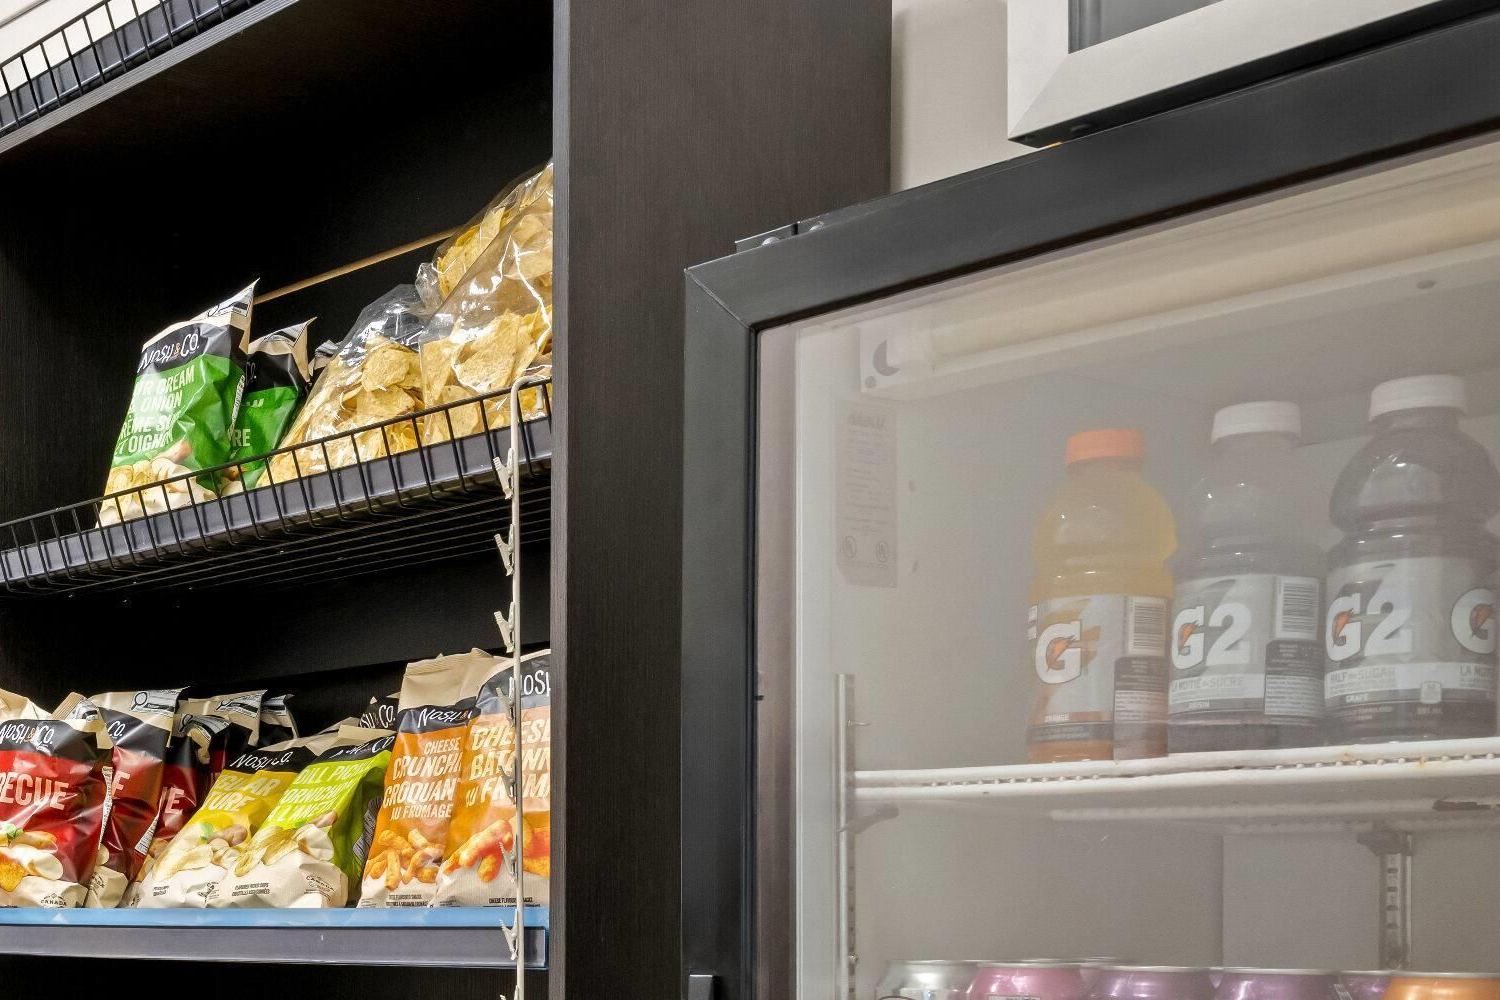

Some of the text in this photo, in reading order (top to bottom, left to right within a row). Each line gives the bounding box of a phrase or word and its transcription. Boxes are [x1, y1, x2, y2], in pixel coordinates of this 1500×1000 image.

[137, 342, 174, 373] NOSH
[119, 413, 155, 441] RÈME
[1171, 602, 1252, 670] G2
[1325, 589, 1413, 662] G2
[1035, 620, 1082, 685] G
[417, 708, 459, 729] NOSH
[402, 803, 453, 820] FROMAGE
